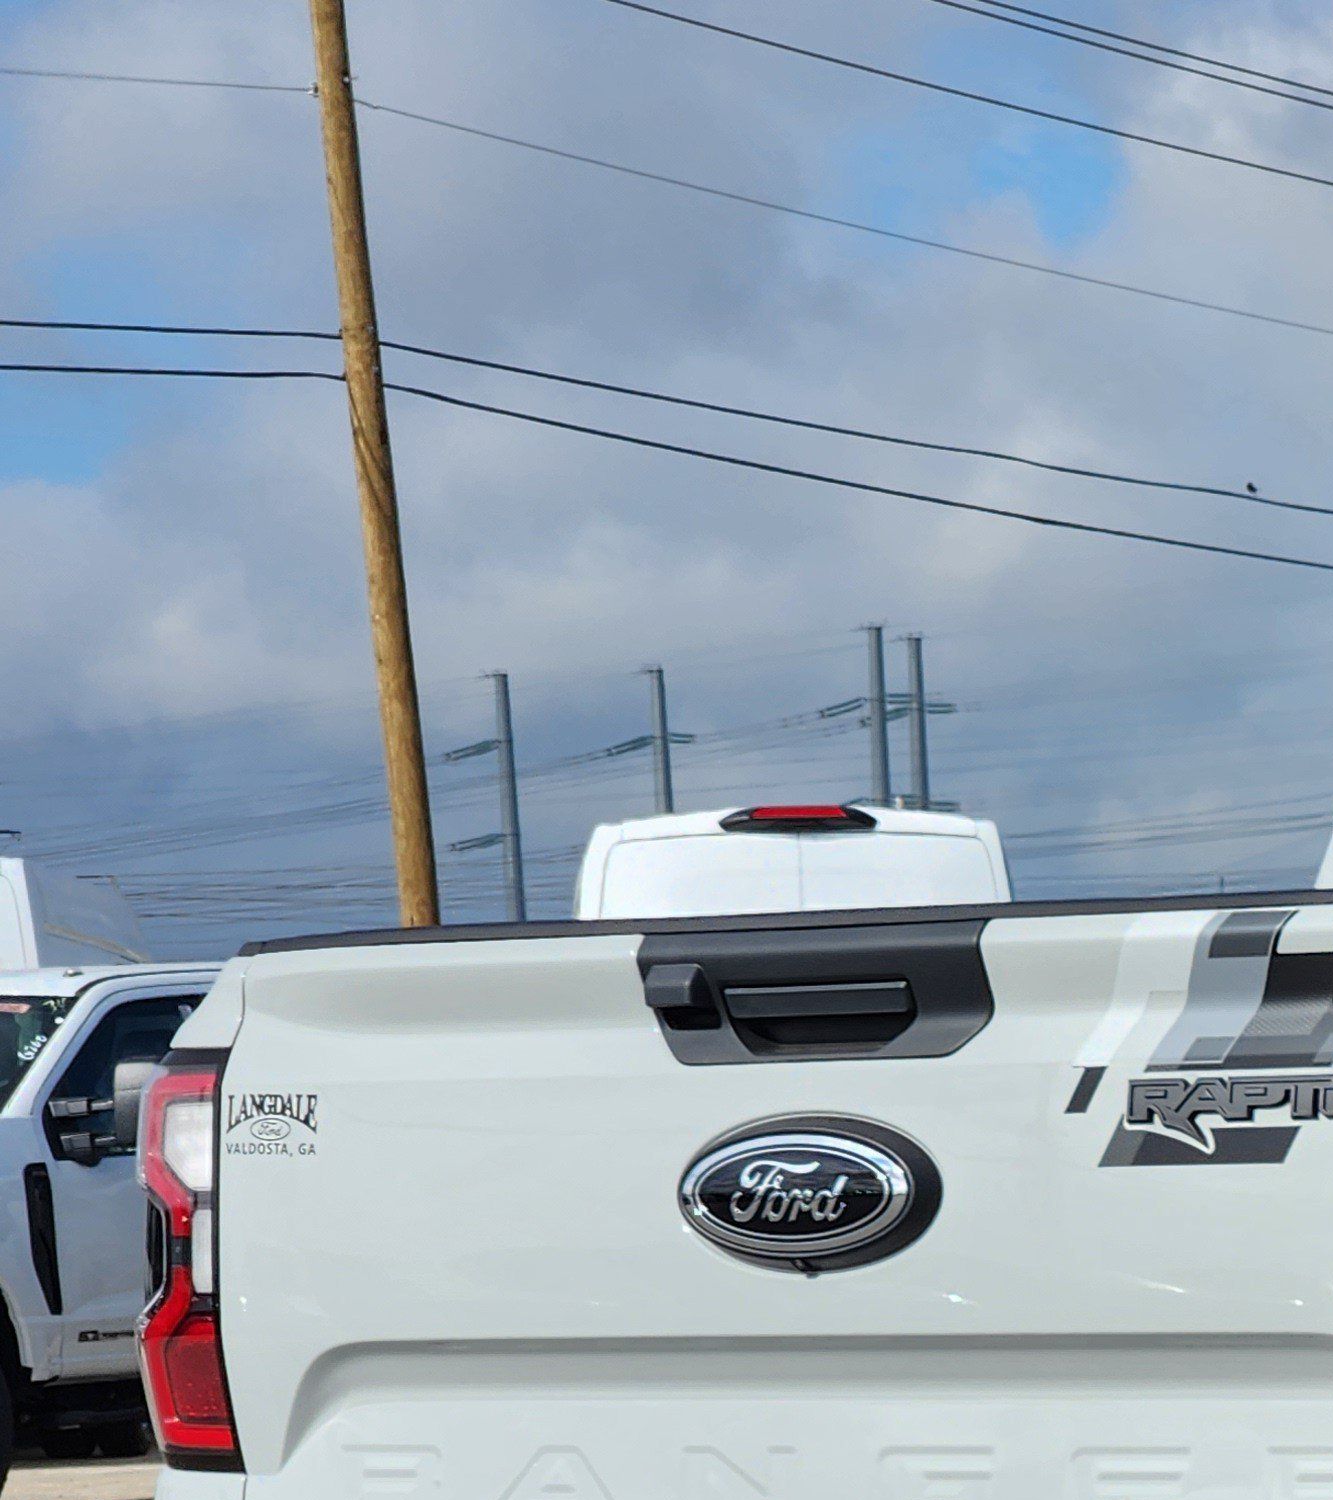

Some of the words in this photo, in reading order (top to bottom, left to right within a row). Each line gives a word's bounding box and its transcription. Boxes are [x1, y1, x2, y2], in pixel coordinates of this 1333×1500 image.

[226, 1093, 318, 1134] LANGDALE
[226, 1142, 294, 1158] VALDOSTA,
[299, 1142, 317, 1156] GA
[730, 1160, 850, 1223] Ford
